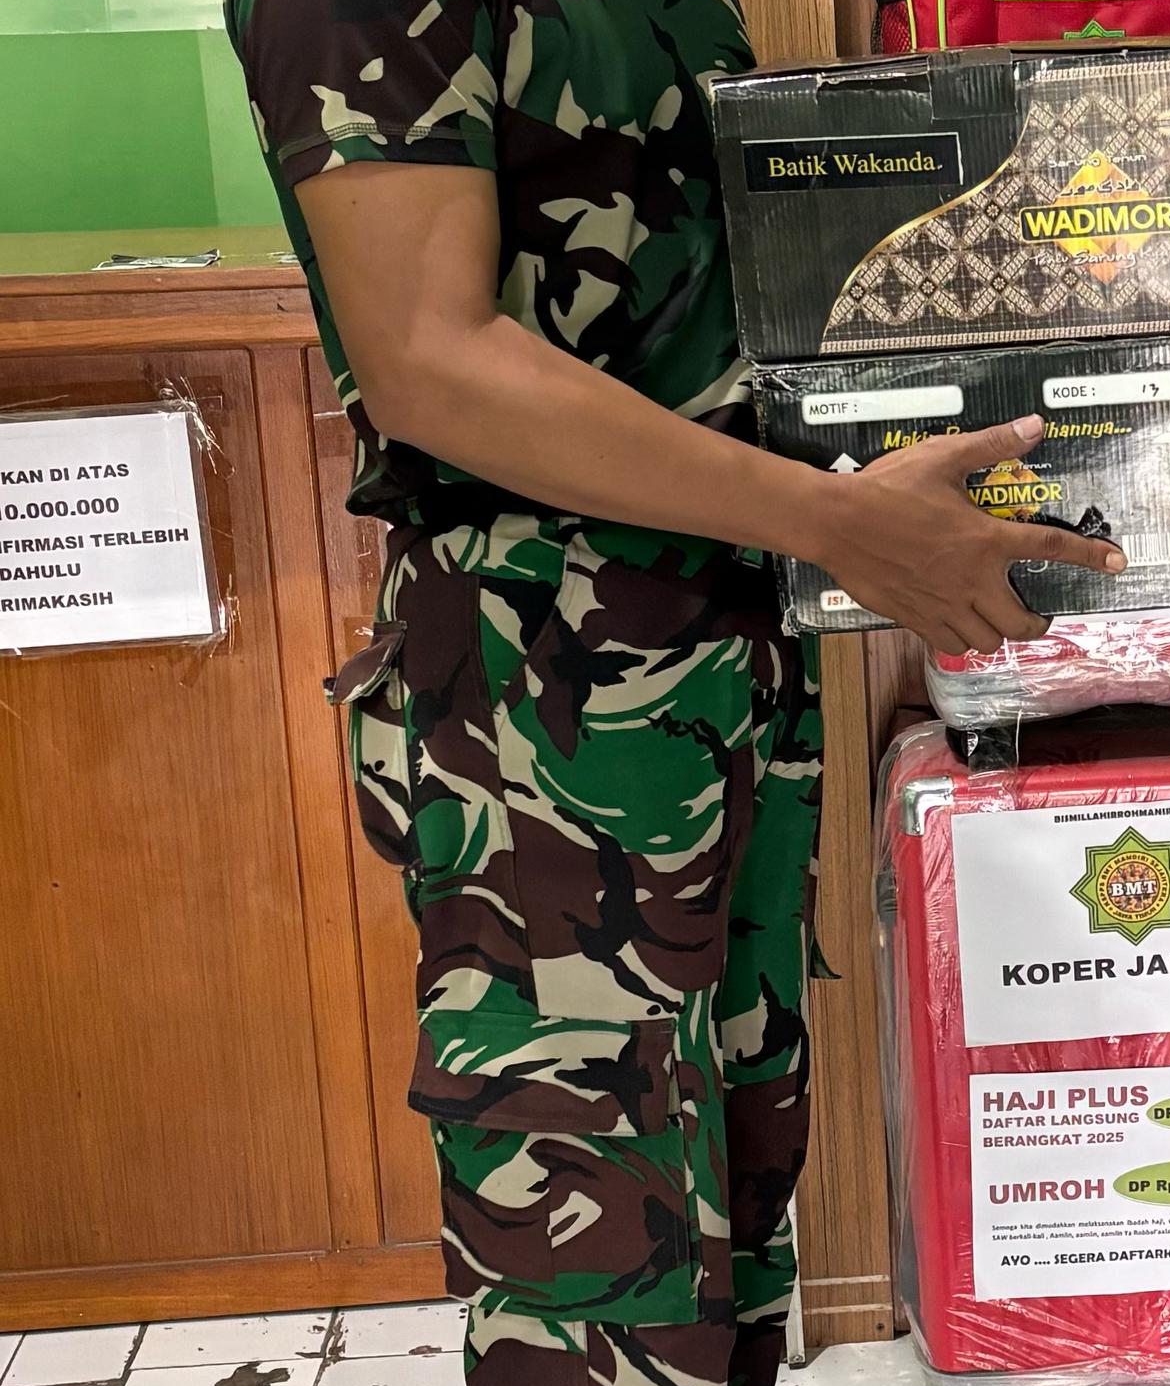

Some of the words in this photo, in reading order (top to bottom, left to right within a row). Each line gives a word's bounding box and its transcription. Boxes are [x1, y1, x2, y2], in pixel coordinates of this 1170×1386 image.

[768, 155, 828, 177] Batik
[1053, 386, 1086, 398] KODE
[810, 403, 848, 415] MOTIF
[50, 467, 70, 482] DI
[77, 464, 130, 480] ATAS
[0, 535, 84, 554] FIRMASI
[90, 528, 189, 548] TERLEBIH
[0, 563, 81, 581] DAHULU
[0, 591, 113, 612] RIMAKASIH
[828, 596, 843, 606] ISI
[1111, 881, 1157, 897] BMT
[1002, 958, 1116, 986] KOPER
[982, 1090, 1056, 1112] HAJI
[1067, 1085, 1149, 1109] PLUS
[982, 1115, 1046, 1129] DAFTAR
[1050, 1112, 1140, 1127] LANGSUNG
[983, 1134, 1082, 1148] BERANGKAT
[1087, 1131, 1124, 1144] 2025
[989, 1178, 1105, 1205] UMROH
[1128, 1180, 1151, 1193] DP
[992, 1224, 1018, 1232] Semoga
[1001, 1256, 1031, 1266] AYO
[1054, 1252, 1105, 1264] SEGERA
